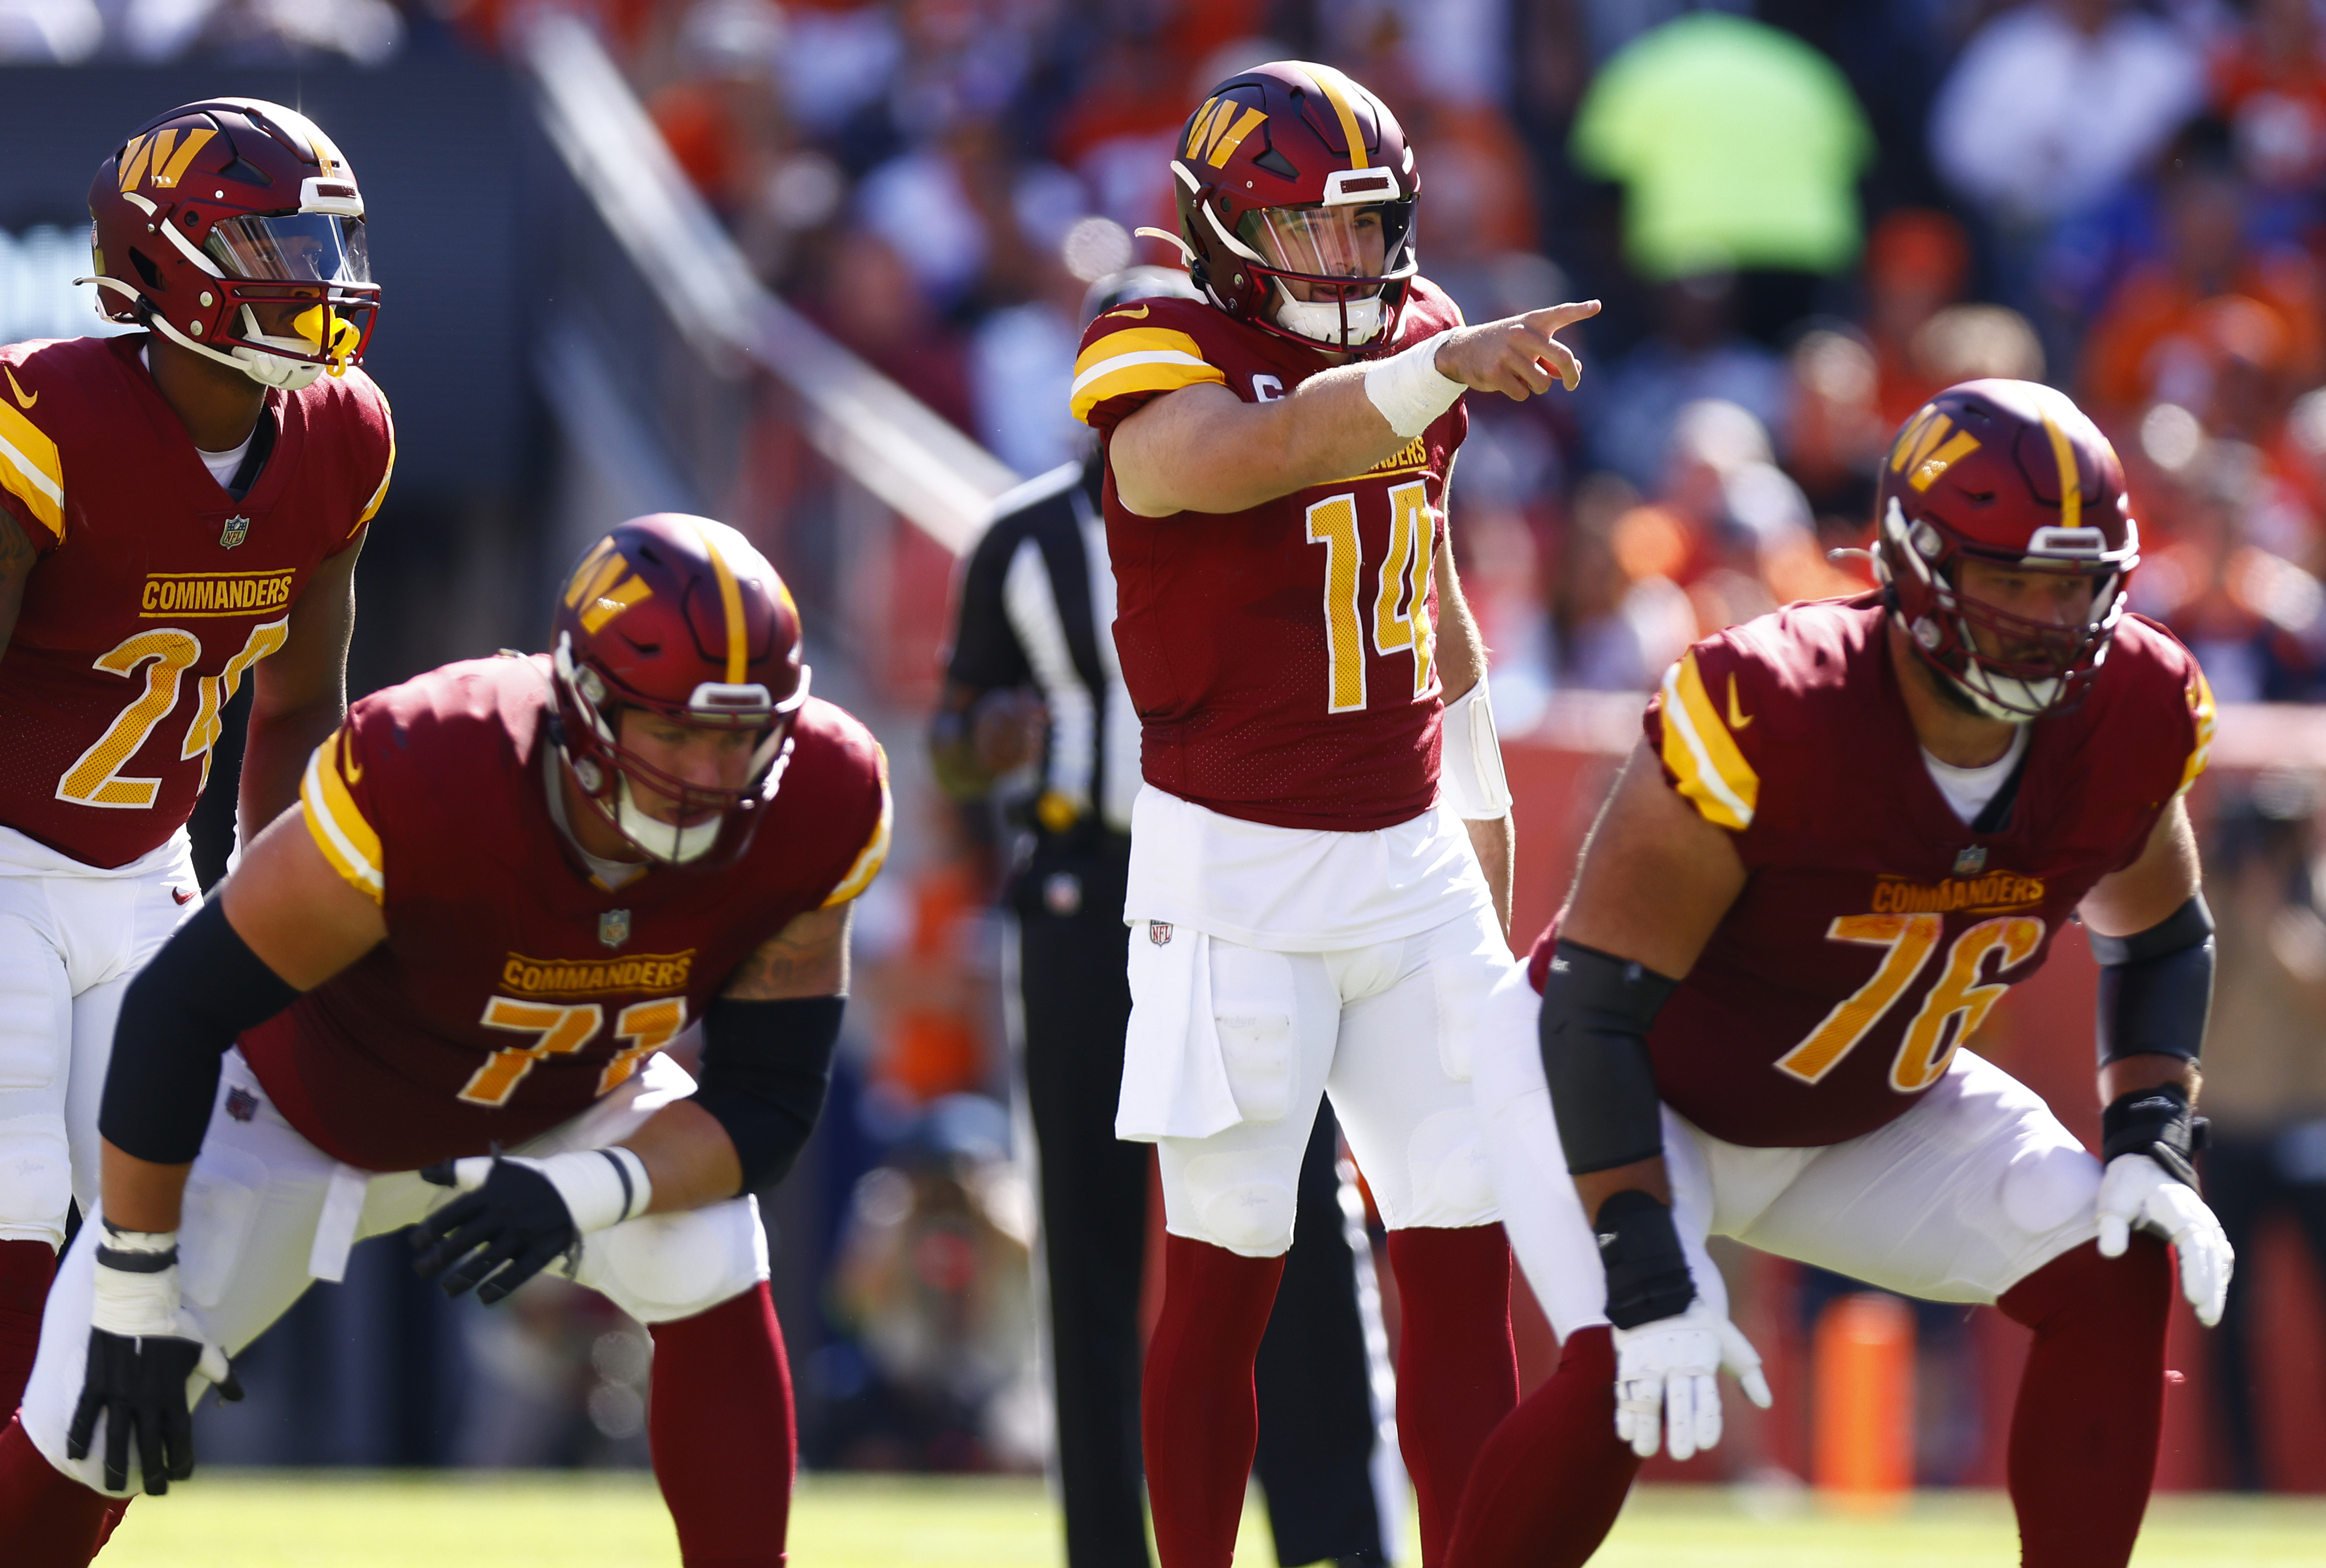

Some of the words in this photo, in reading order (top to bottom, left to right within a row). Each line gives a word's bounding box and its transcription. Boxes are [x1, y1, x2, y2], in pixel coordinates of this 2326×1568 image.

[1252, 374, 1285, 404] C
[224, 532, 241, 543] NFL
[142, 576, 292, 610] COMMANDERS
[1306, 478, 1436, 714] 14
[1872, 877, 2045, 913] COMMANDERS
[1153, 925, 1171, 943] NFL
[504, 956, 692, 991] COMMANDERS
[1773, 912, 2046, 1095] 76
